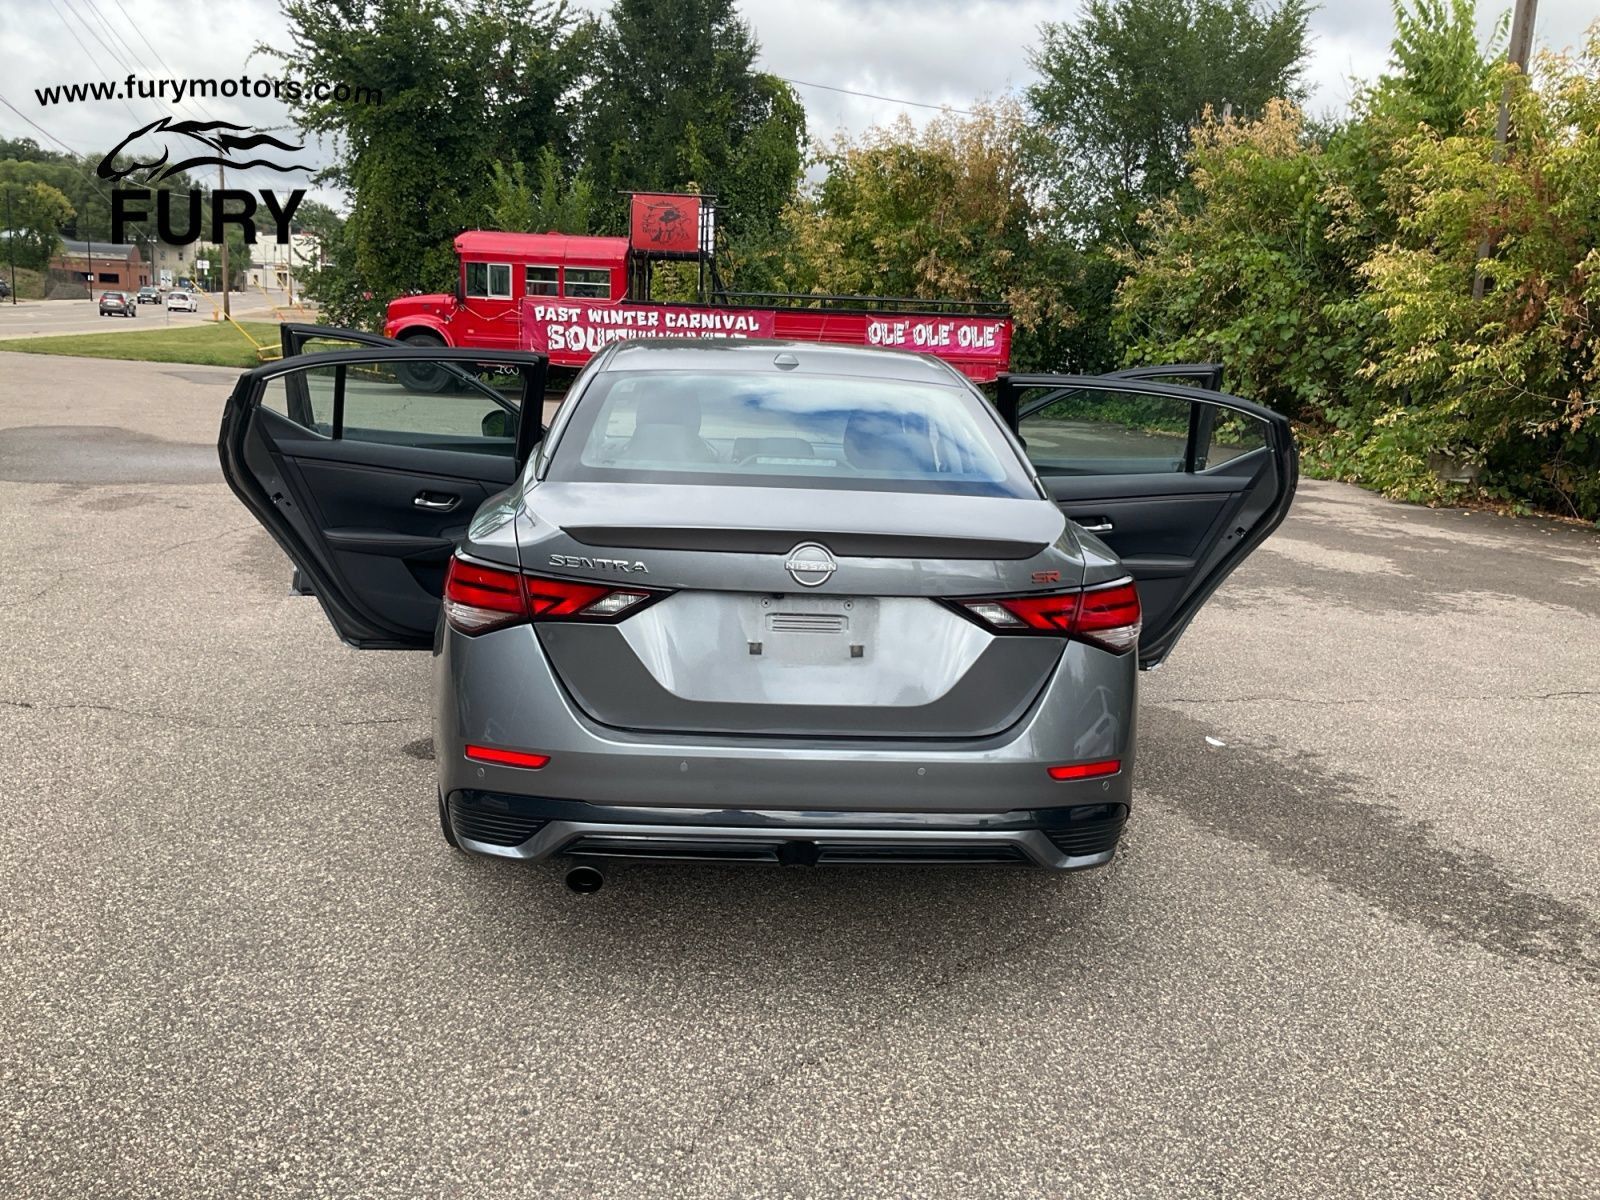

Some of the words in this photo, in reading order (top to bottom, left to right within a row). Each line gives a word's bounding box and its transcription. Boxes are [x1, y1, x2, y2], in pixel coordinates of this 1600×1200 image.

[534, 306, 581, 322] PAST
[588, 309, 659, 326] WINTER
[665, 313, 759, 331] CARNIVAL
[549, 554, 649, 573] SENTRA
[786, 561, 836, 571] NISSAN
[1031, 570, 1059, 584] SR
